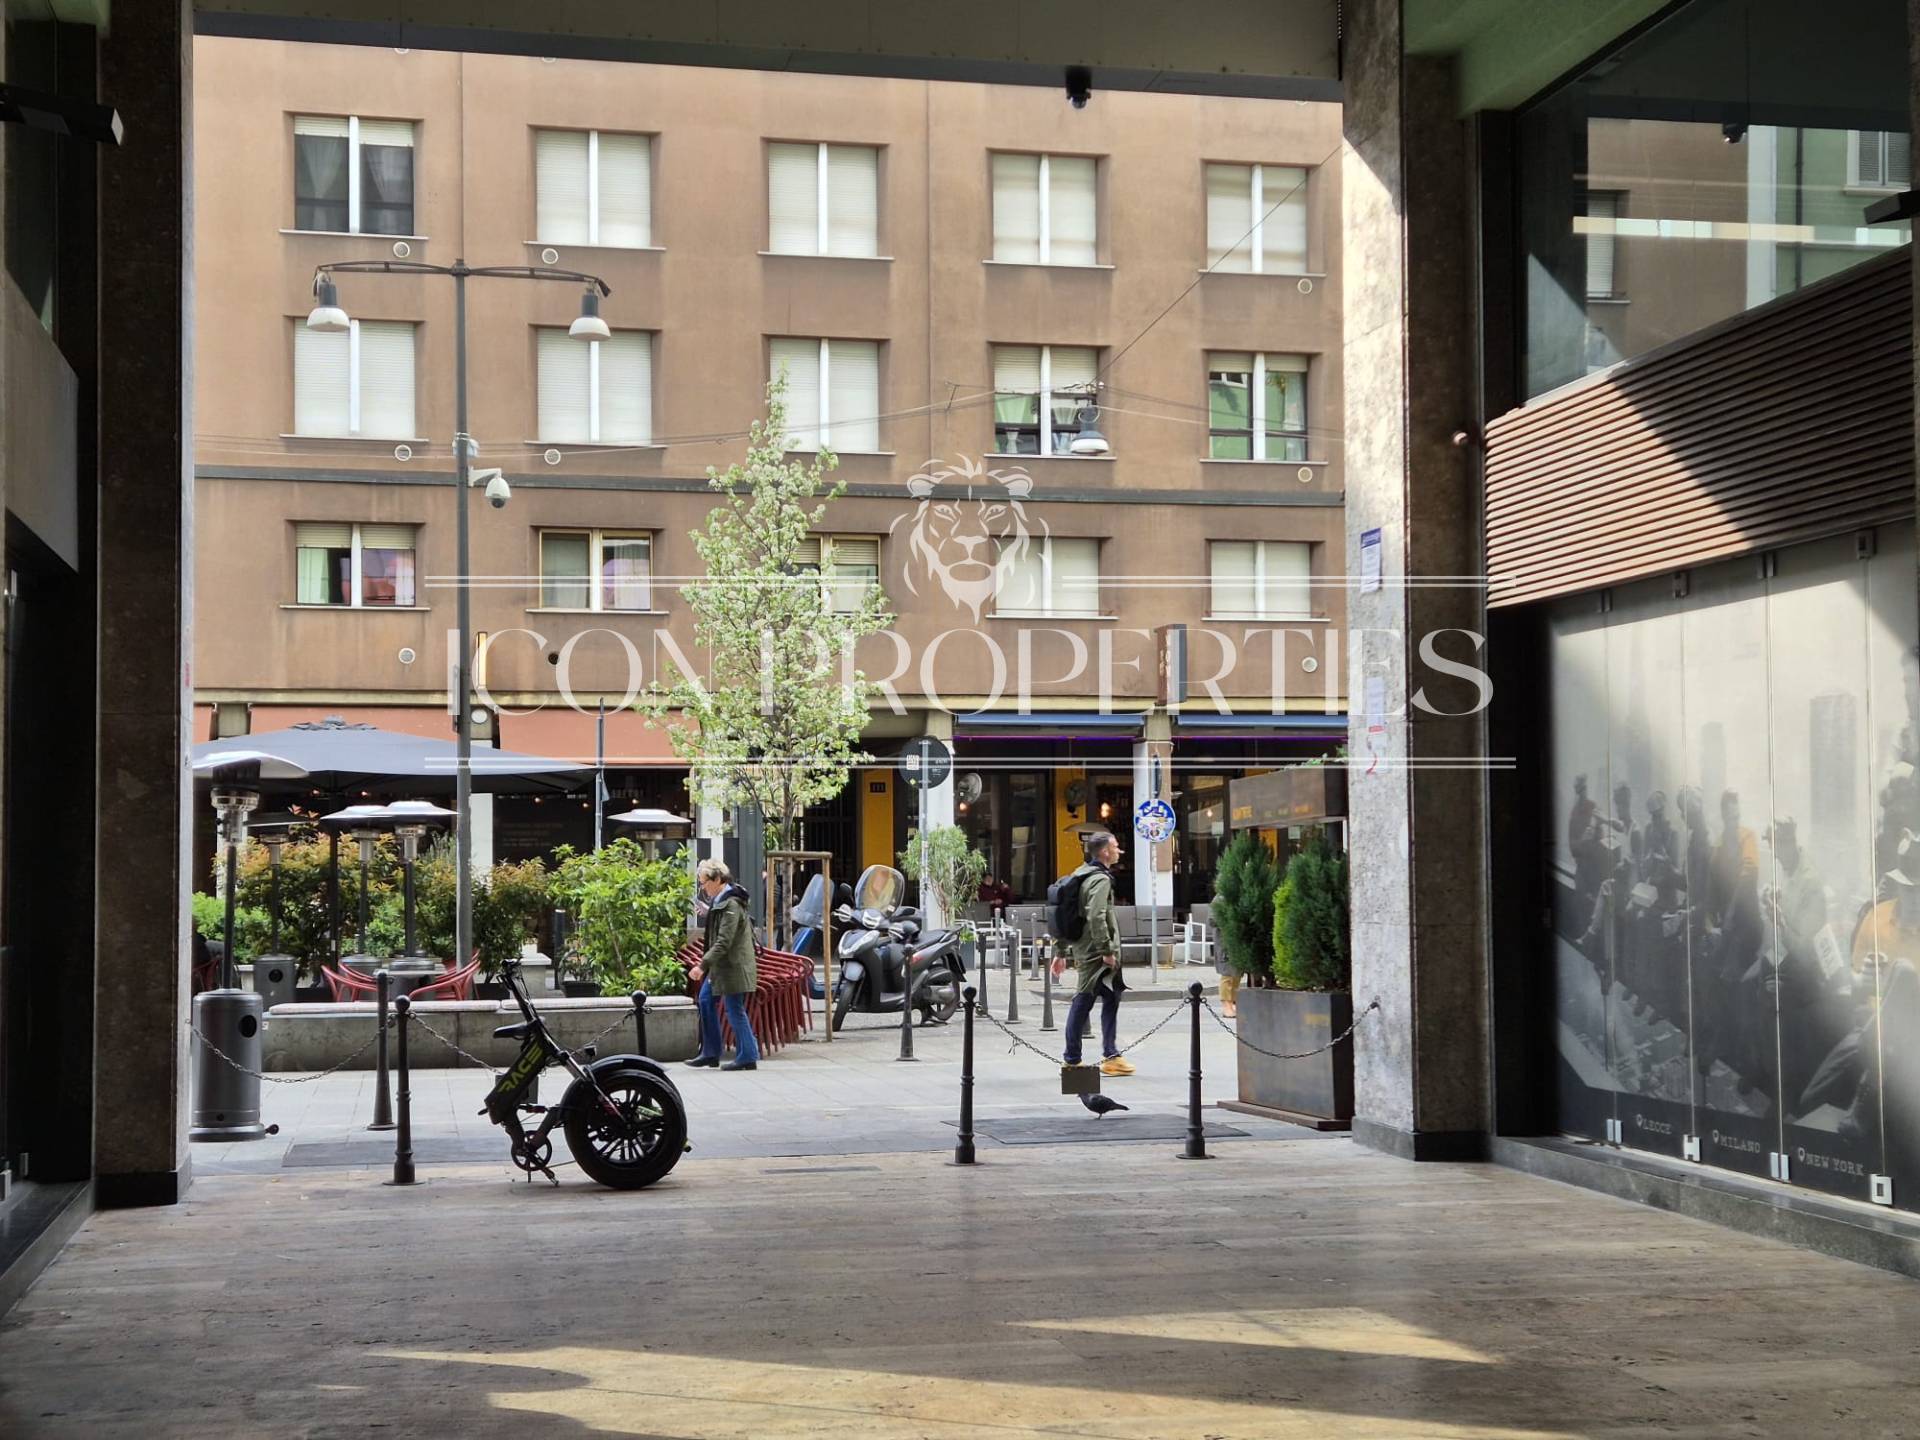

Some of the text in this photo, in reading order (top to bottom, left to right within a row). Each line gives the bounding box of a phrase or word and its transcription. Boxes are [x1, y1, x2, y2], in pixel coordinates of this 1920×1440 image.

[497, 1042, 543, 1092] RACE
[1720, 1134, 1761, 1154] MILANO
[1806, 1152, 1864, 1176] NEW YORK
